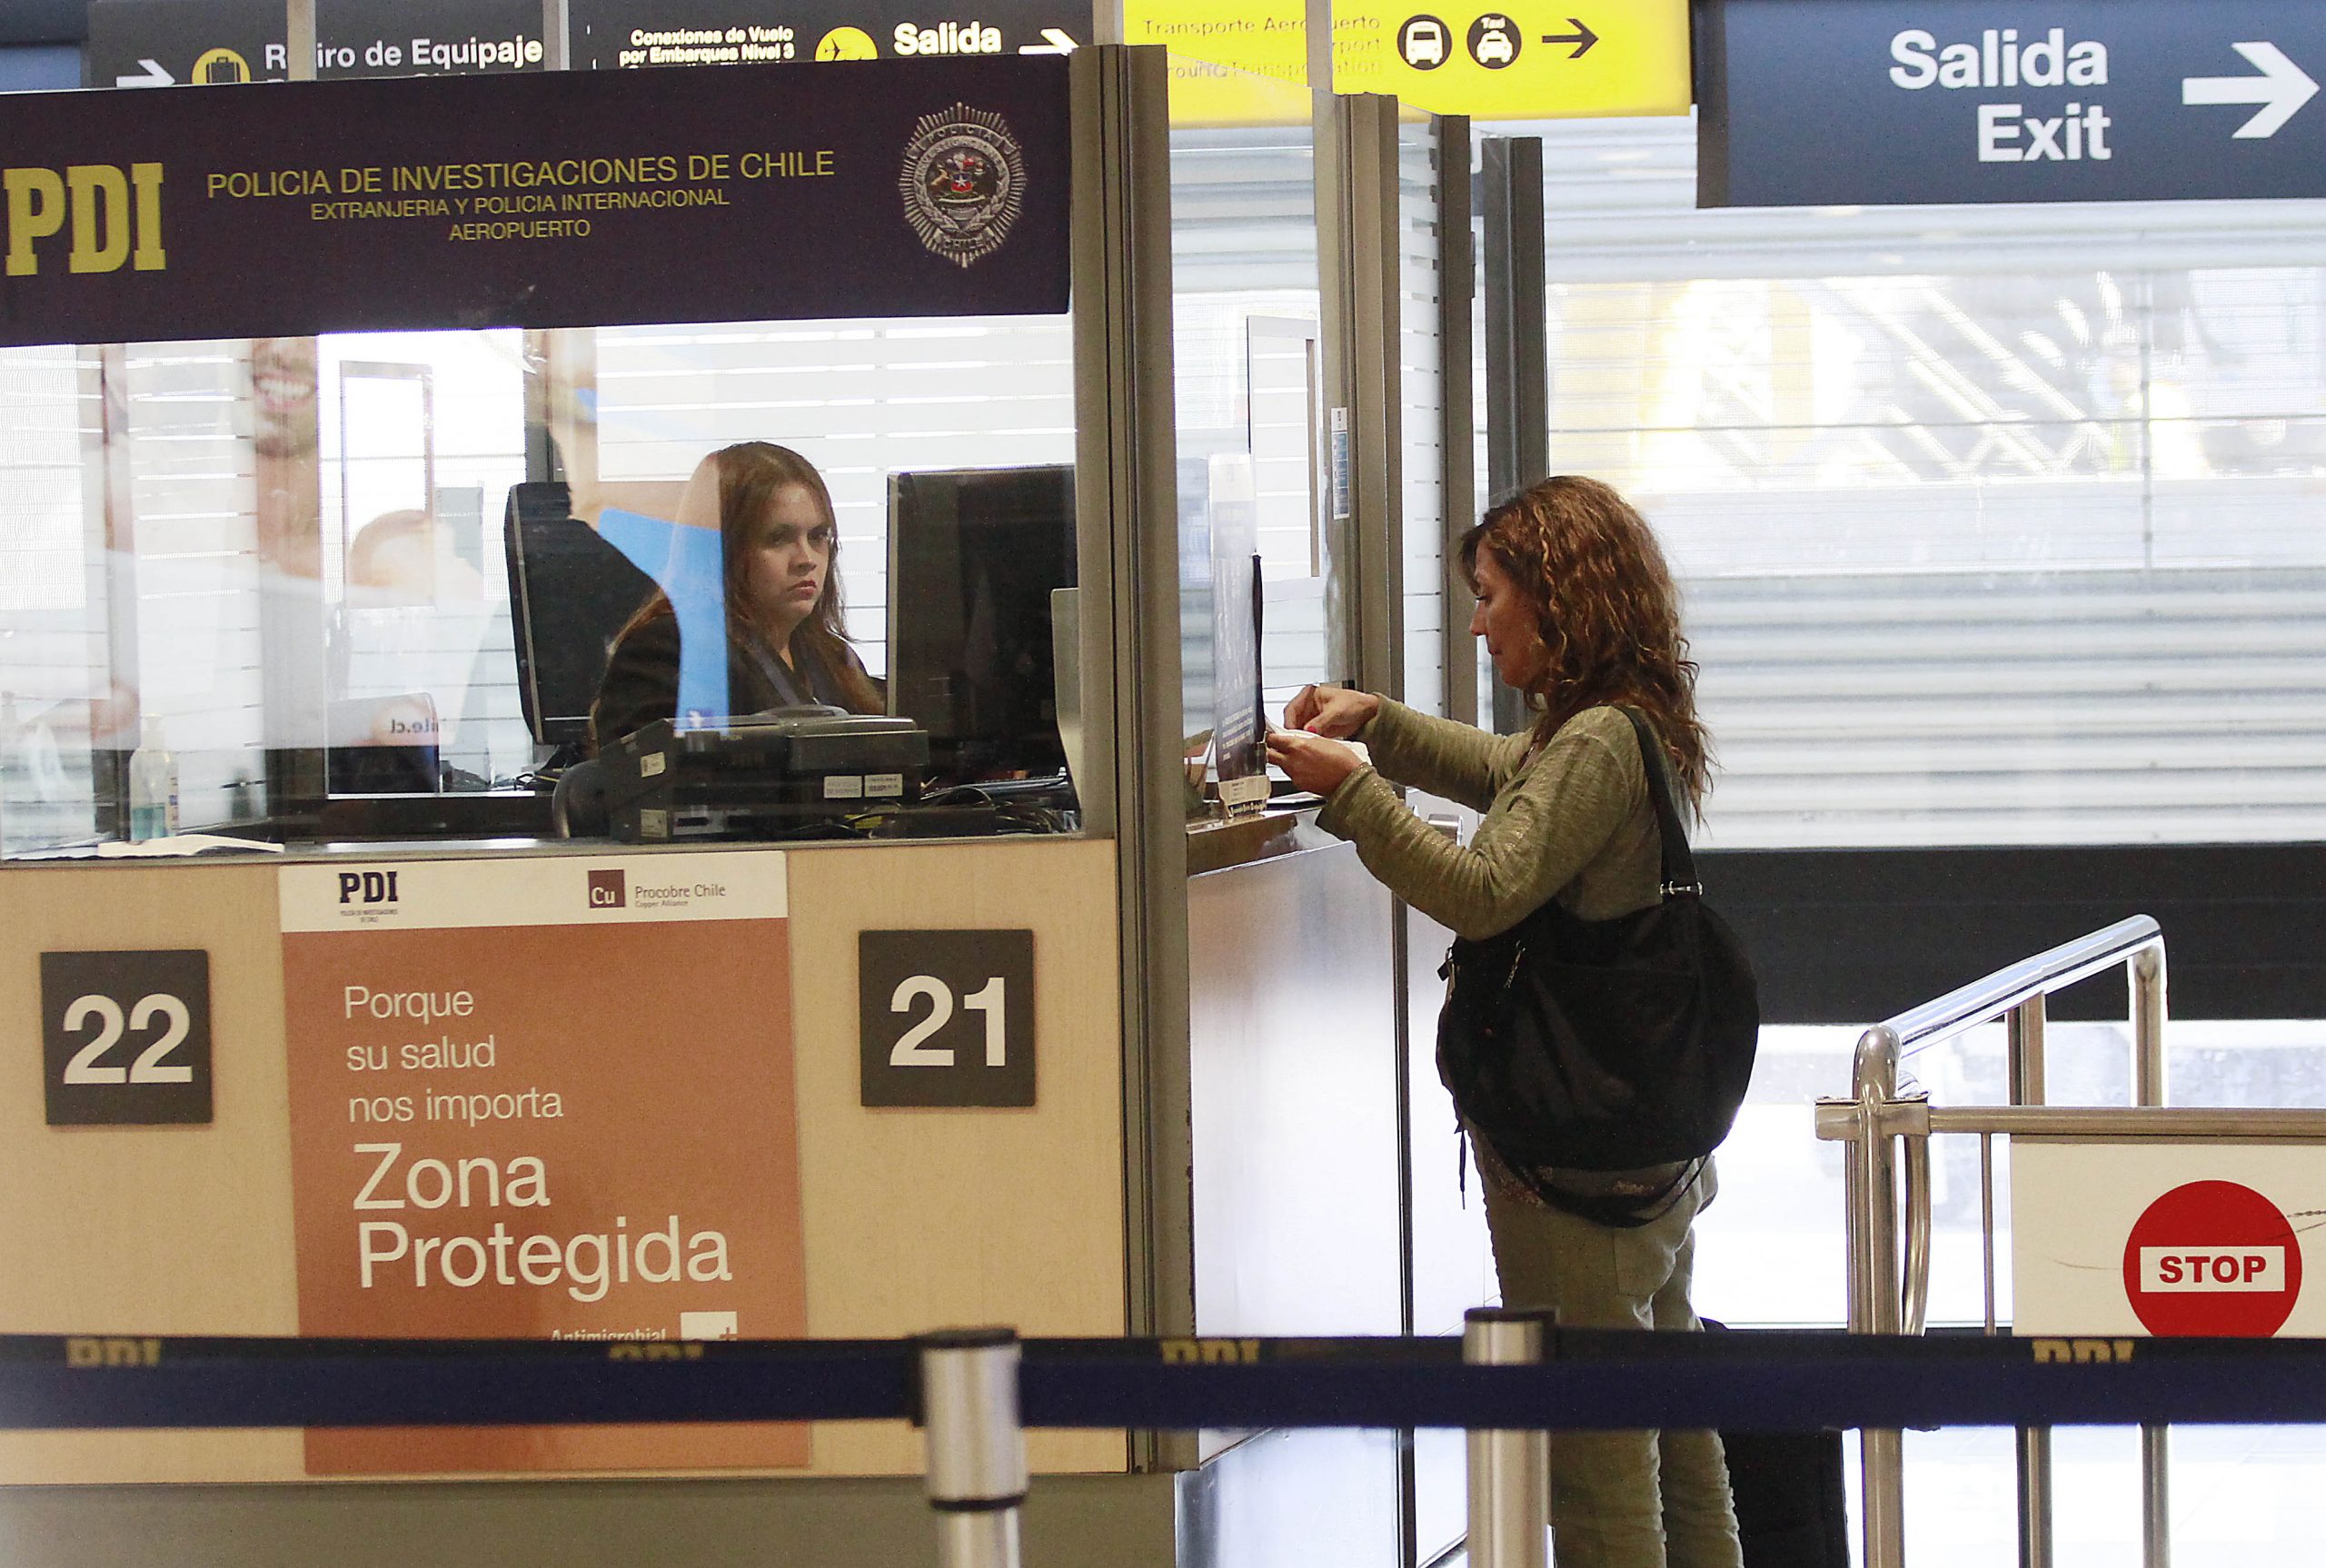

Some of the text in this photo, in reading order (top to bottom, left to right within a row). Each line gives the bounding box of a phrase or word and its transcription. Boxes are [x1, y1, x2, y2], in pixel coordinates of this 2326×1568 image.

[631, 25, 794, 46] Conexiones de Vuelo
[893, 20, 1002, 55] Salida
[1142, 19, 1255, 37] Transporte
[264, 35, 543, 70] Riro de Equipaje
[619, 49, 647, 67] por
[649, 45, 739, 65] Embarques
[741, 43, 780, 61] Nivel
[782, 42, 795, 59] 3
[1889, 27, 2109, 90] Salida
[1977, 102, 2112, 163] Exit
[207, 151, 836, 198] POLICIA DE INVESTIGACIONES DE CHILE
[3, 162, 166, 276] PDI
[311, 188, 730, 220] EXTRANJERIA Y POLICIA INTERNACIONAL
[449, 219, 591, 241] AEROPUERTO
[339, 871, 398, 903] PDI
[591, 887, 615, 905] Cu
[635, 884, 726, 898] Procobre Chile
[344, 986, 474, 1025] Porque
[890, 975, 1006, 1067] 21
[63, 993, 193, 1084] 22
[346, 1034, 495, 1071] su salud
[349, 1087, 564, 1126] nos importa
[353, 1142, 551, 1210] Zona
[360, 1215, 732, 1303] Protegida
[2159, 1255, 2266, 1283] STOP
